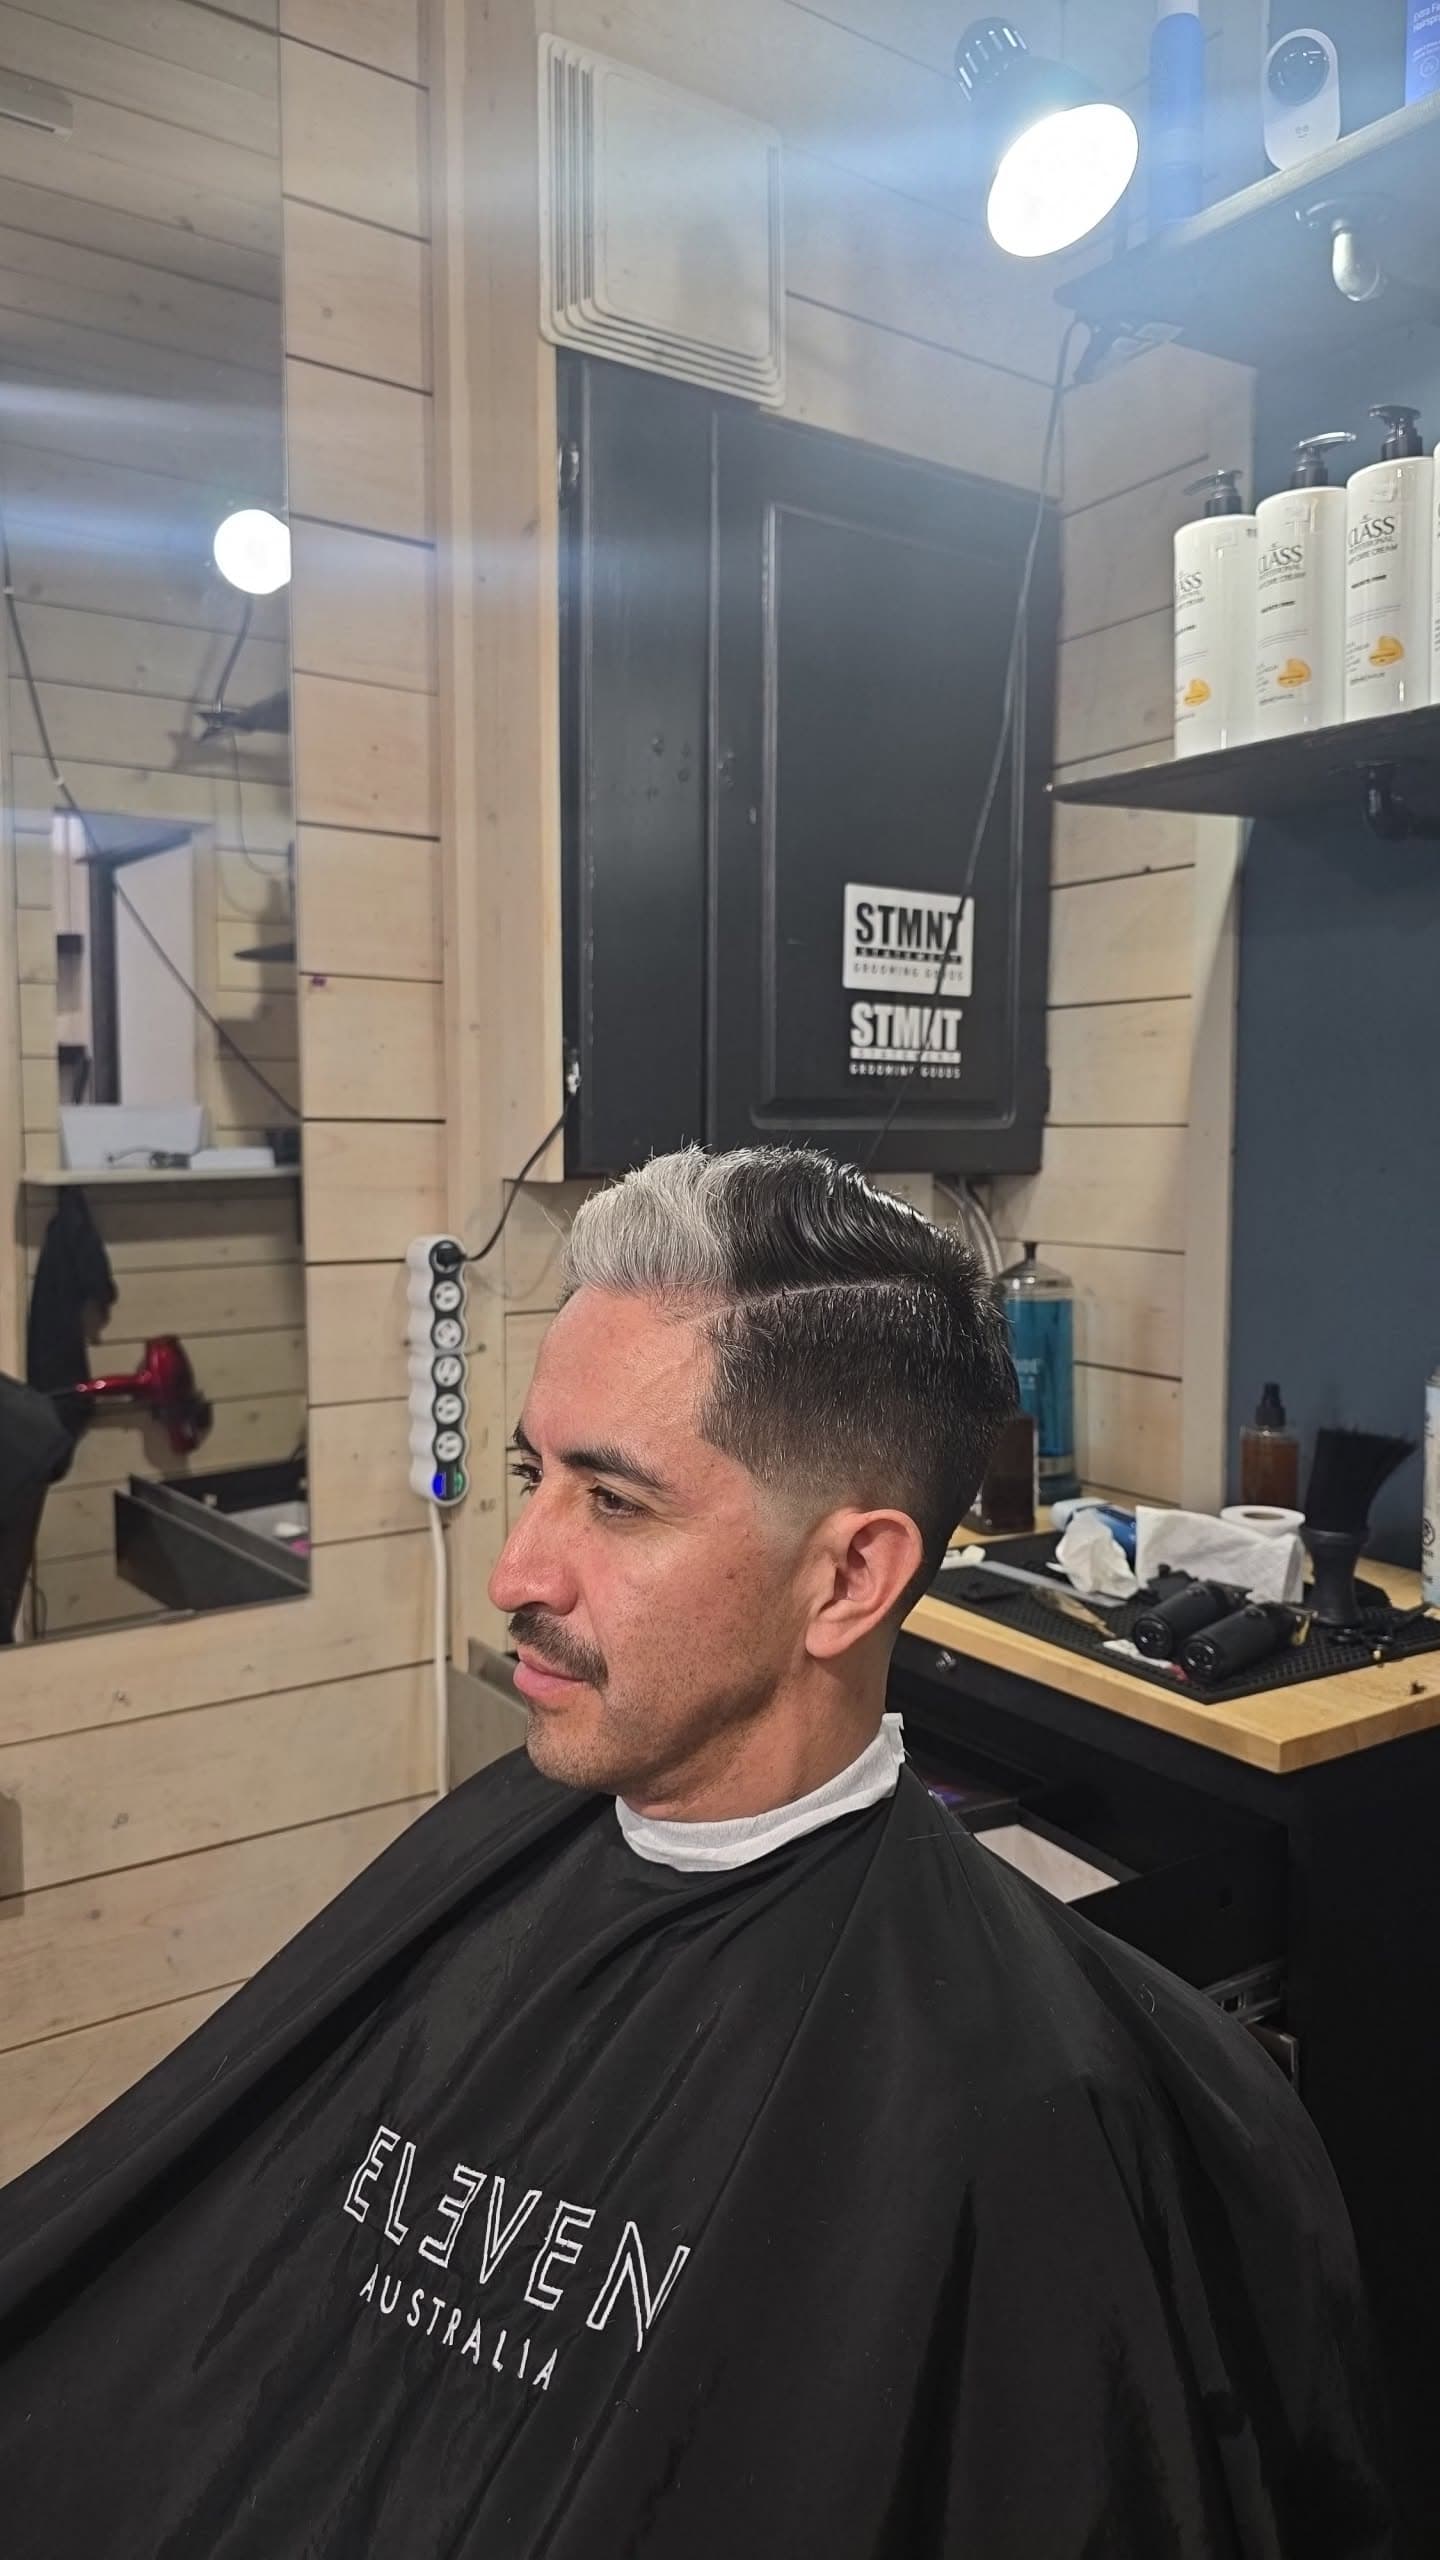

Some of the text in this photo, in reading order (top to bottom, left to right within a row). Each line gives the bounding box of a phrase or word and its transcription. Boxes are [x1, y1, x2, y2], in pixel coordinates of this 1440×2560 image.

[856, 902, 962, 951] STMNT
[925, 968, 963, 982] GODS
[850, 1002, 963, 1051] STMNT
[343, 2125, 691, 2352] ELEVEN
[359, 2263, 557, 2390] AUSTRALIA
